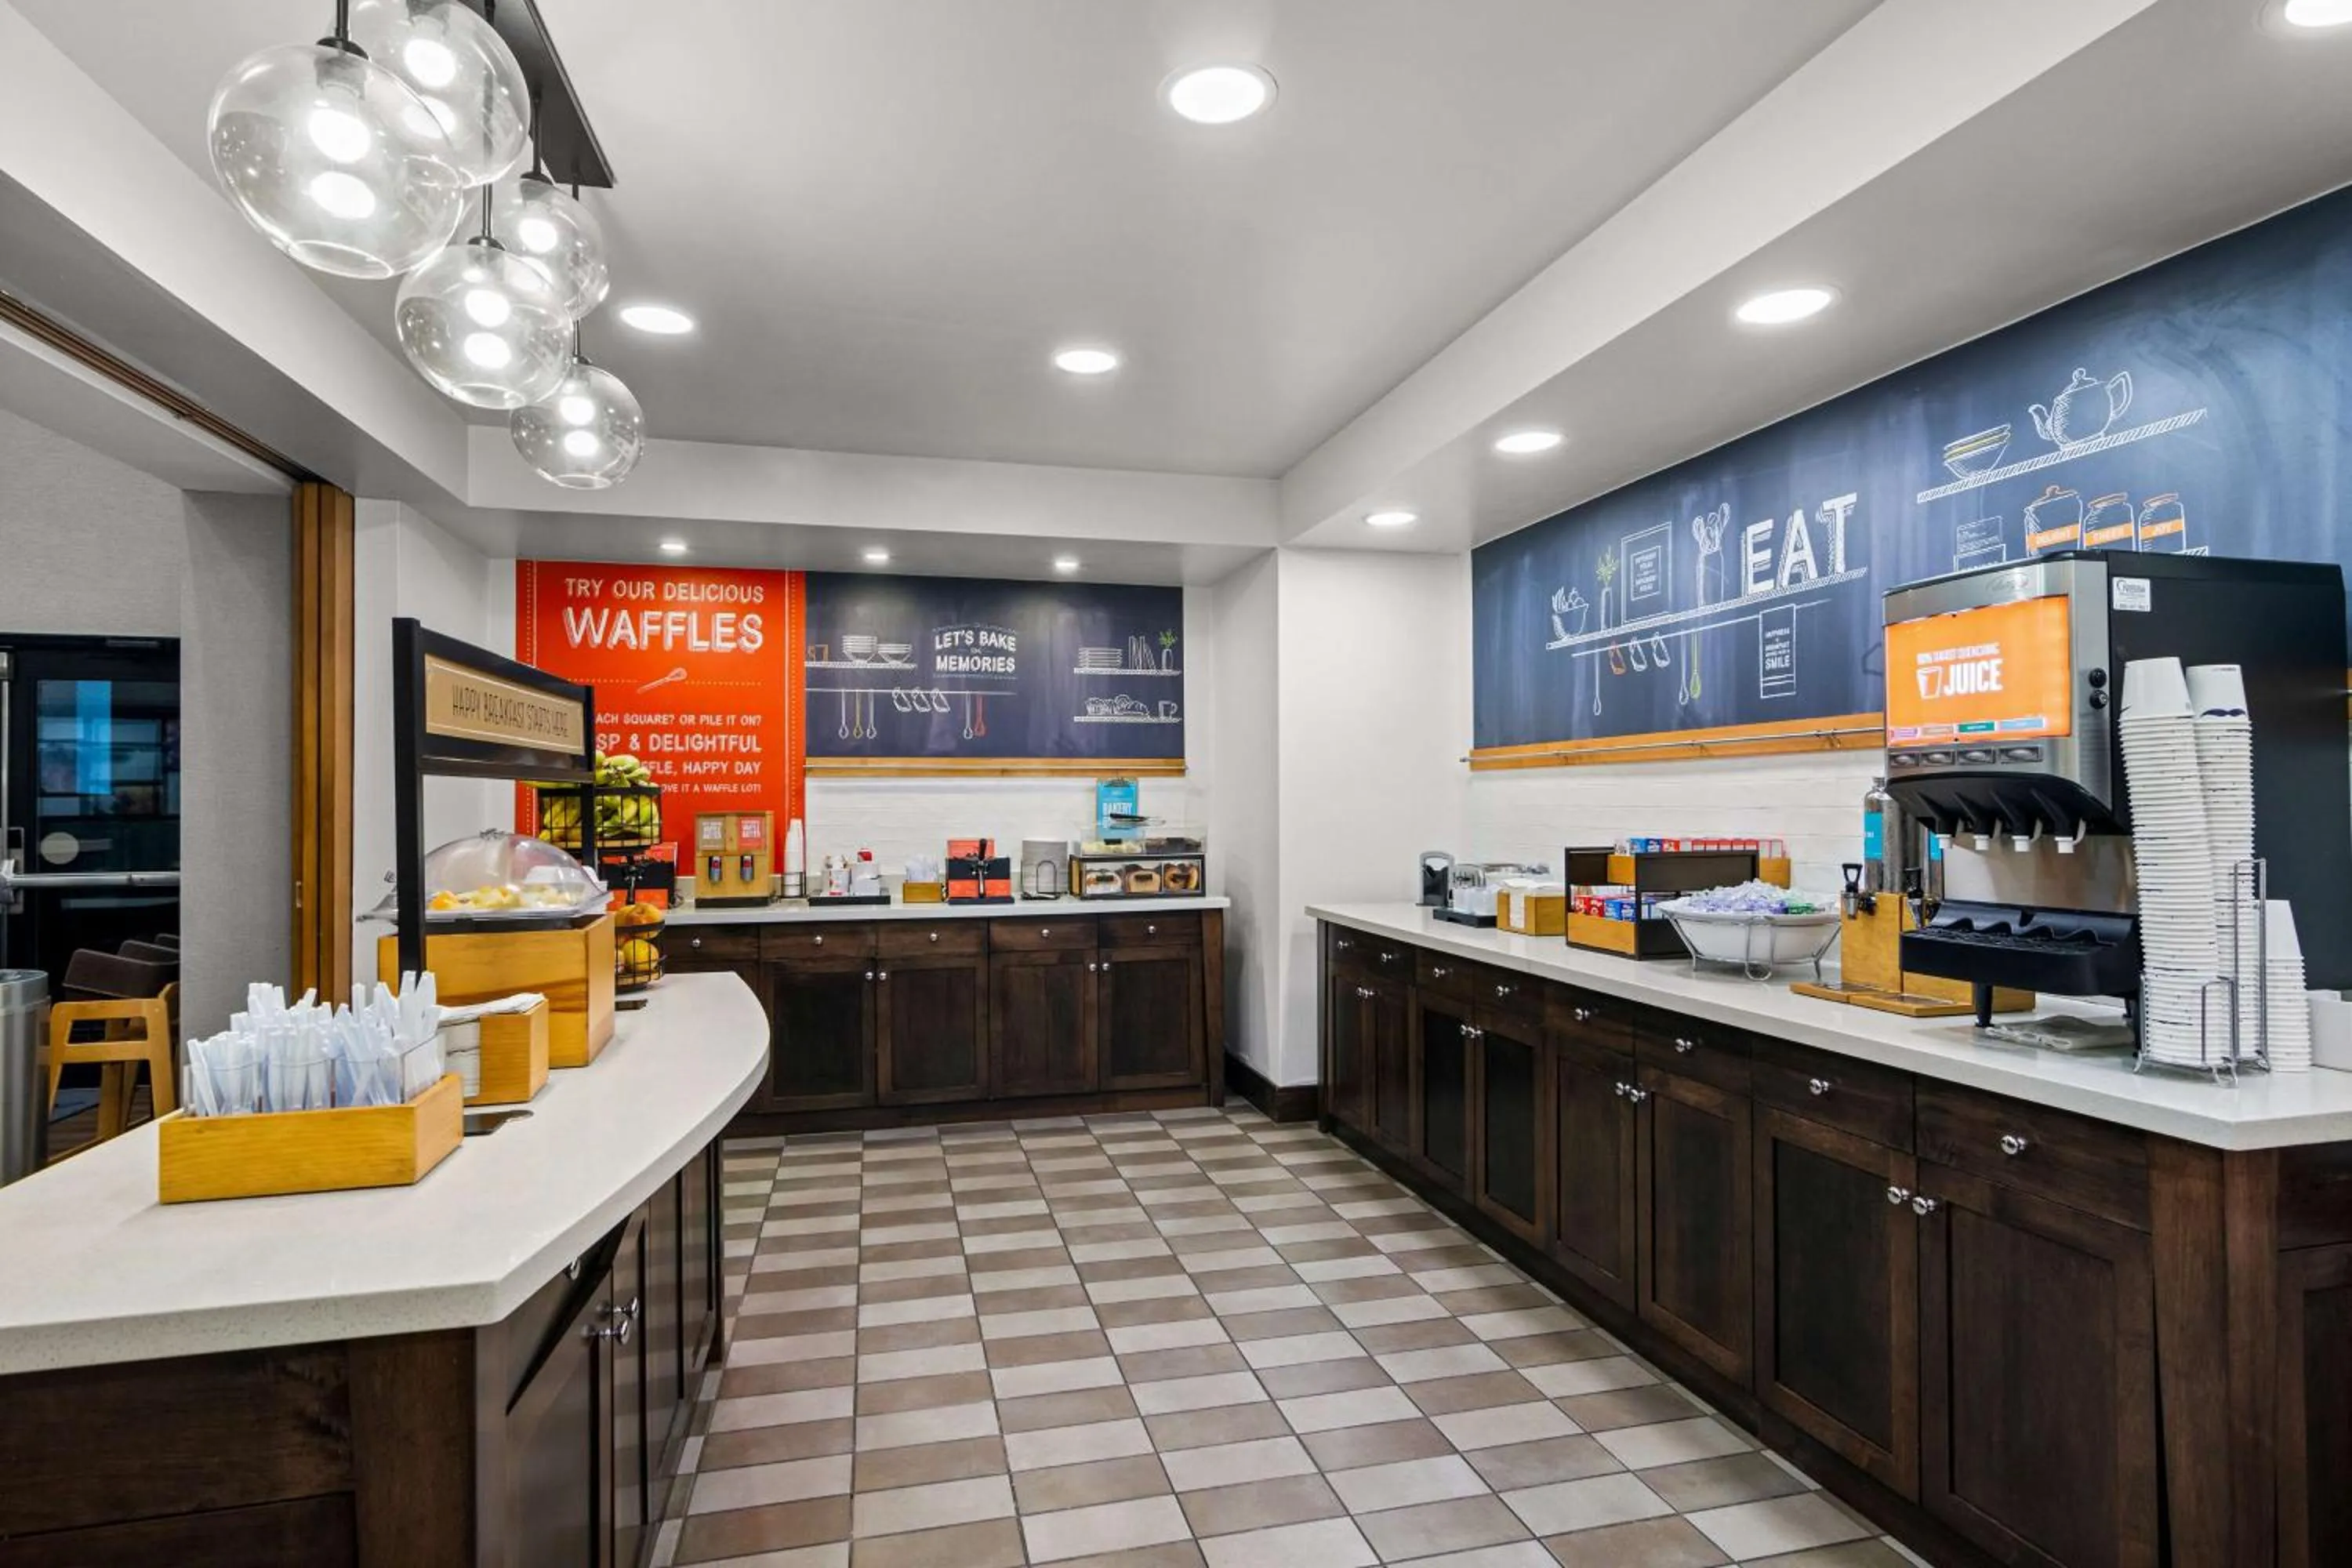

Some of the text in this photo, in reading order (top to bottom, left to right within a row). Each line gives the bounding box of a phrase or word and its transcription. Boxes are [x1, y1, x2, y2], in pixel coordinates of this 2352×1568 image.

[1742, 492, 1857, 597] EAT
[564, 577, 764, 604] TRY OUR DELICIOUS
[562, 606, 764, 653] WAFFLES
[935, 630, 1016, 652] LET'S BAKE
[935, 655, 1015, 673] MEMORIES
[1944, 658, 2003, 696] JUICE
[452, 684, 481, 720] HAPPY
[595, 713, 762, 726] ACH SQUARE? OR PILE IT ON?
[629, 732, 641, 751] &
[648, 733, 762, 753] DELIGHTFUL
[683, 760, 728, 775] HAPPY
[734, 761, 762, 775] DAY
[662, 783, 678, 793] OVE
[681, 783, 691, 793] IT
[693, 783, 700, 793] A
[703, 783, 739, 793] WAFFLE
